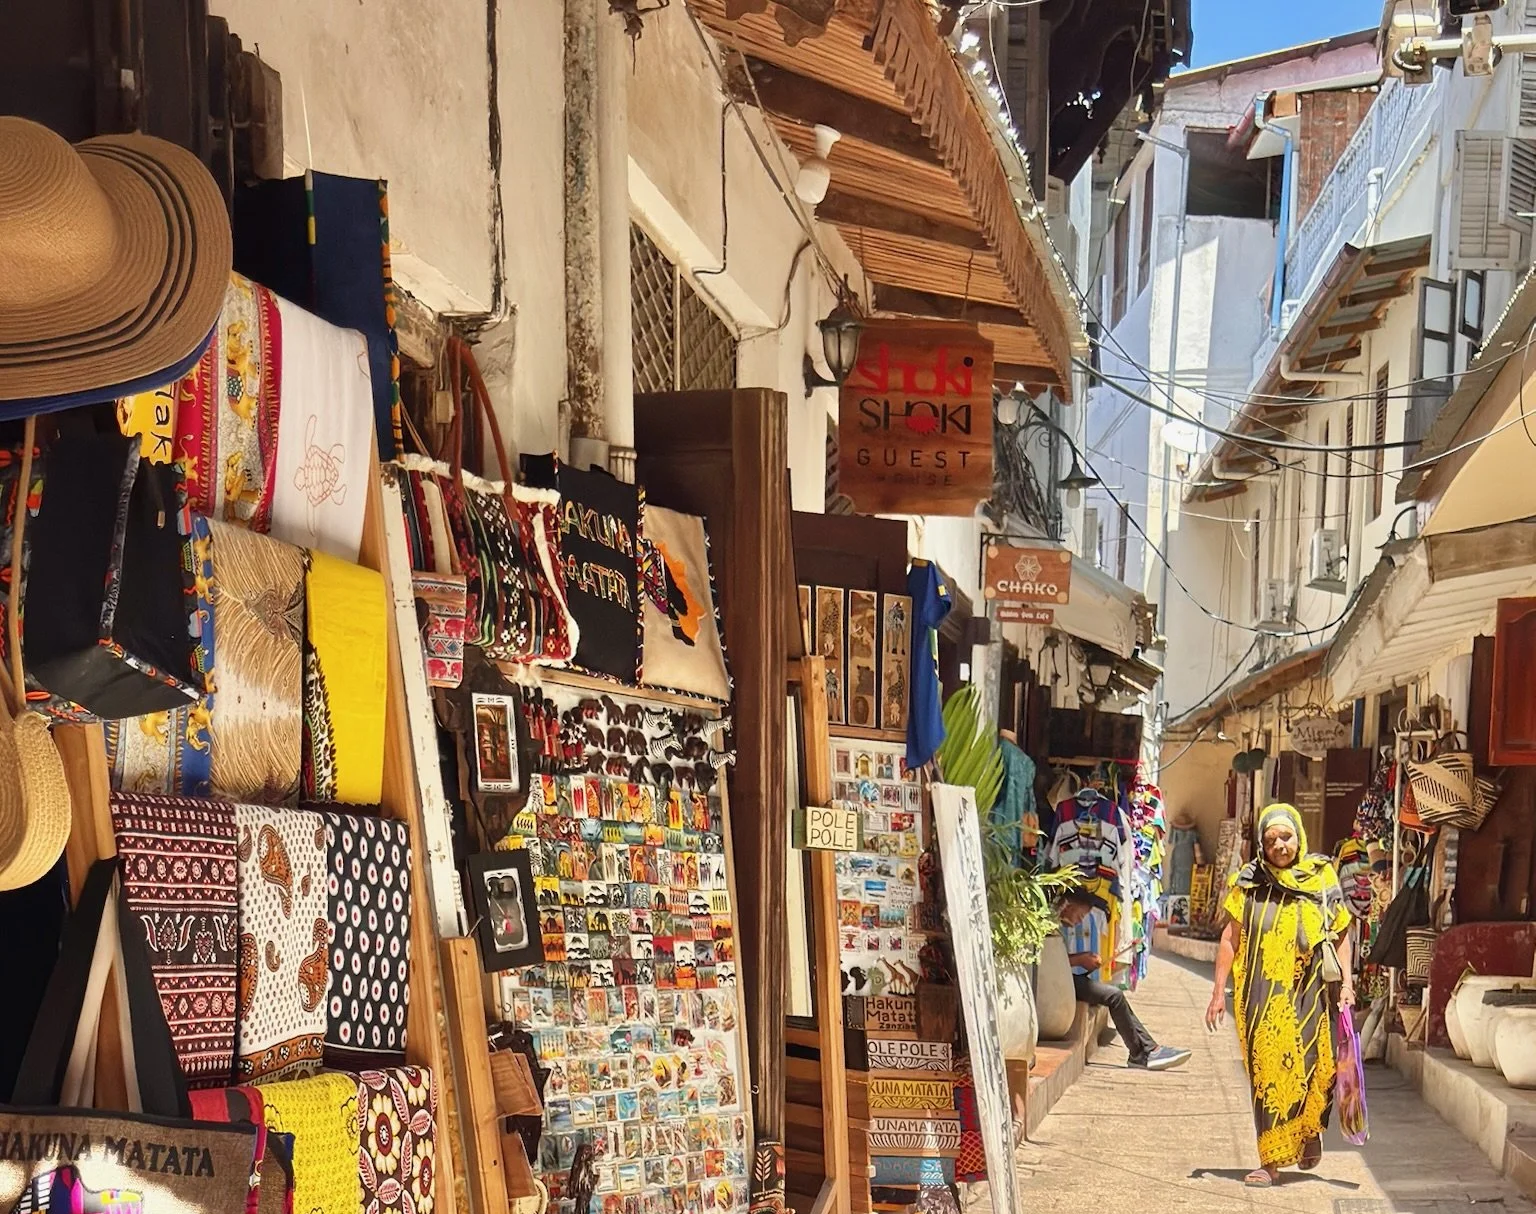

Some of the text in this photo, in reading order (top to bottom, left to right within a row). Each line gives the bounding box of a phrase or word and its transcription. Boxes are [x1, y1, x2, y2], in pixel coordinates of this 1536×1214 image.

[857, 448, 971, 469] GUEST
[560, 500, 634, 558] AKUNA
[997, 580, 1058, 596] CHAKO
[811, 810, 856, 829] POLE
[810, 828, 854, 847] POLE
[867, 1041, 938, 1057] OLE POLE
[903, 1082, 948, 1097] MATATA
[103, 1134, 215, 1178] MATATA
